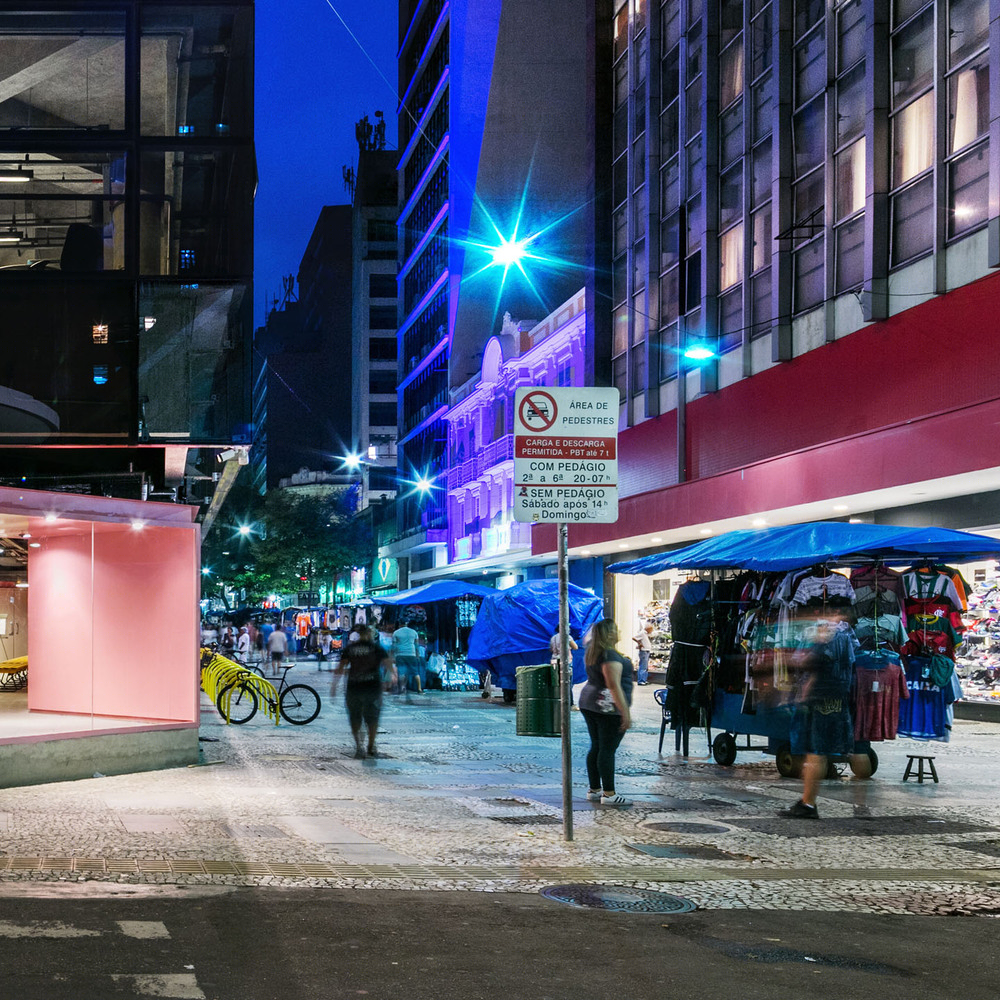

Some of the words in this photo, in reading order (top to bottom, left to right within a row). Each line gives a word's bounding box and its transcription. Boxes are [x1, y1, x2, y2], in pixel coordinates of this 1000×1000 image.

[569, 400, 593, 409] ÁREA
[596, 402, 608, 410] DE
[562, 417, 615, 425] PEDESTRES
[586, 449, 597, 457] até
[530, 462, 554, 471] COM
[558, 461, 606, 471] PEDÁGIO
[530, 489, 553, 498] SEM
[557, 487, 605, 498] PEDÁGIO
[522, 499, 560, 508] Sábado
[563, 499, 588, 510] após
[542, 510, 587, 521] Domingo
